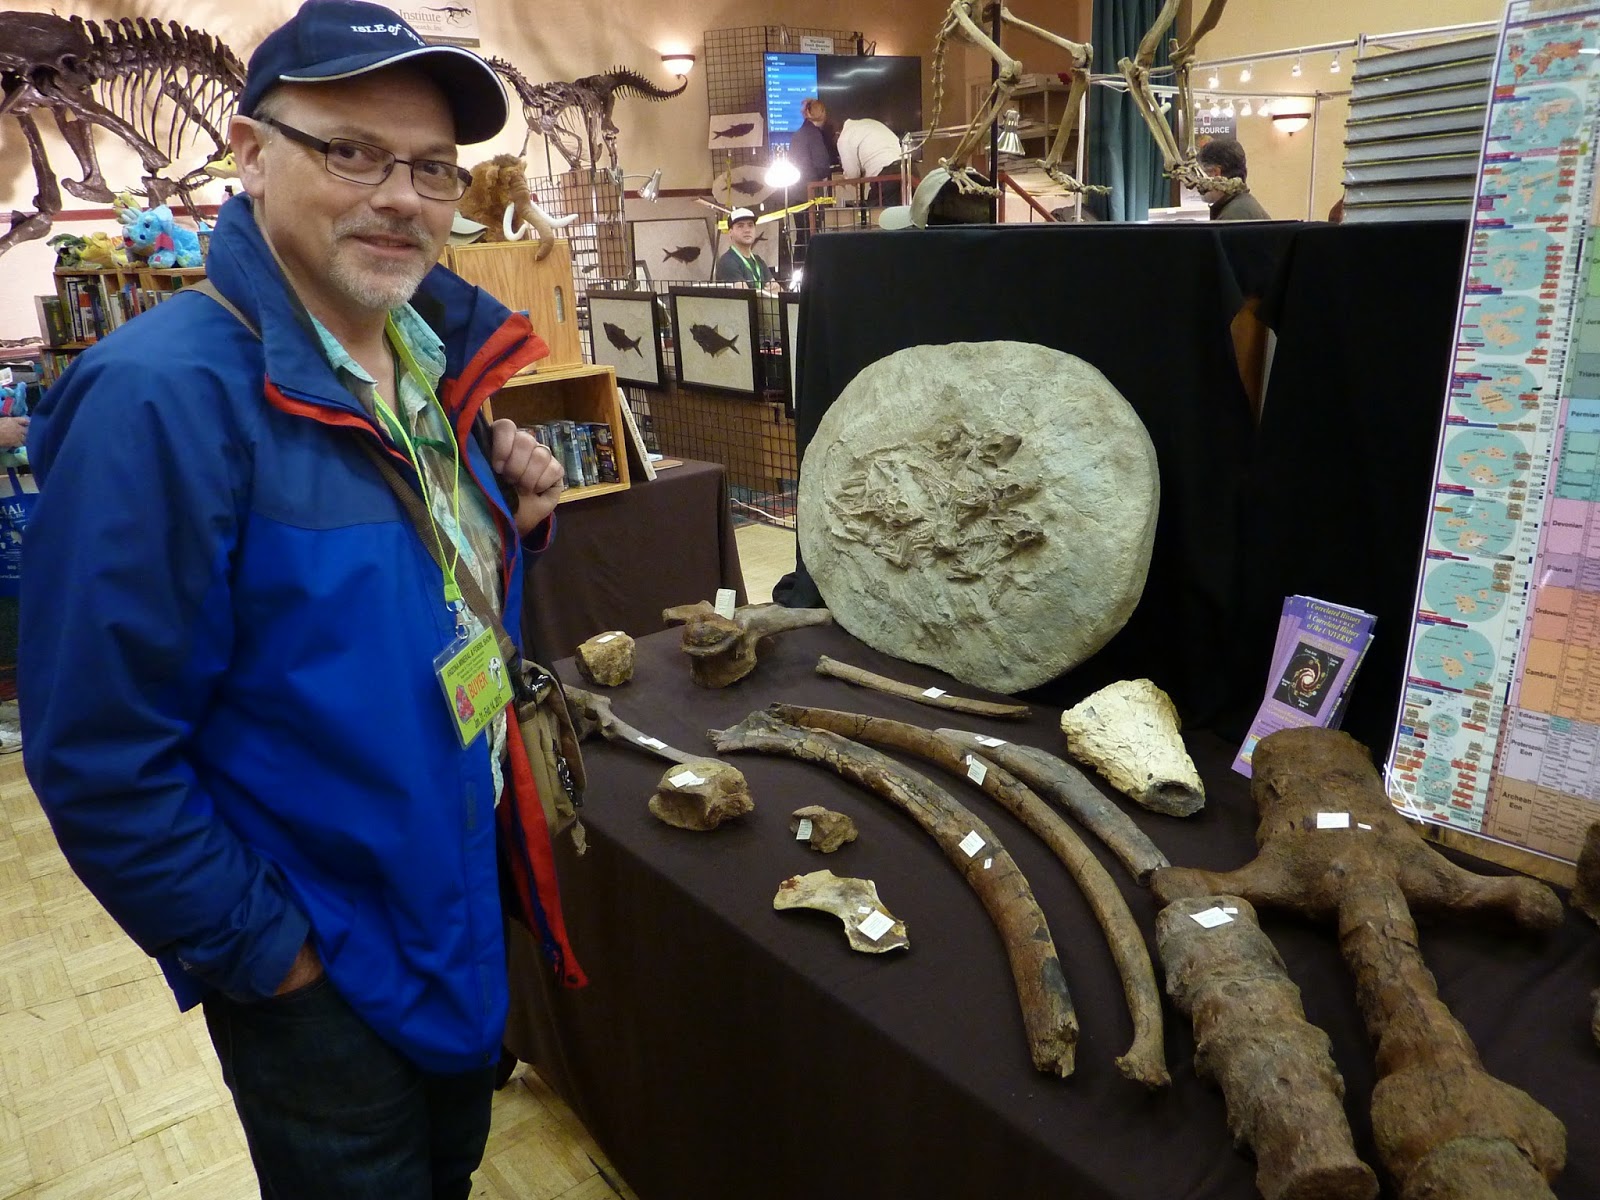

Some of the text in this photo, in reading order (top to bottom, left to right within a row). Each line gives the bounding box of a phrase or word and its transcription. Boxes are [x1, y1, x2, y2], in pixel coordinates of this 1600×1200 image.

[350, 23, 402, 36] ISLE of
[1200, 126, 1230, 134] SOURCE
[1552, 520, 1583, 529] Devonian
[1311, 602, 1341, 617] Correlated
[1341, 611, 1361, 623] History
[1536, 608, 1568, 617] Ordovician
[1312, 615, 1341, 630] Correlated
[1340, 625, 1360, 638] History
[1313, 624, 1322, 633] the
[1322, 628, 1353, 644] UNIVERSE
[1525, 668, 1557, 680] Cambrian
[468, 671, 488, 699] BUYER
[1512, 740, 1543, 752] Proterozoic
[1520, 749, 1533, 757] Eon
[1502, 792, 1532, 804] Archean
[1509, 802, 1523, 811] Eon
[1498, 826, 1522, 838] Hadean
